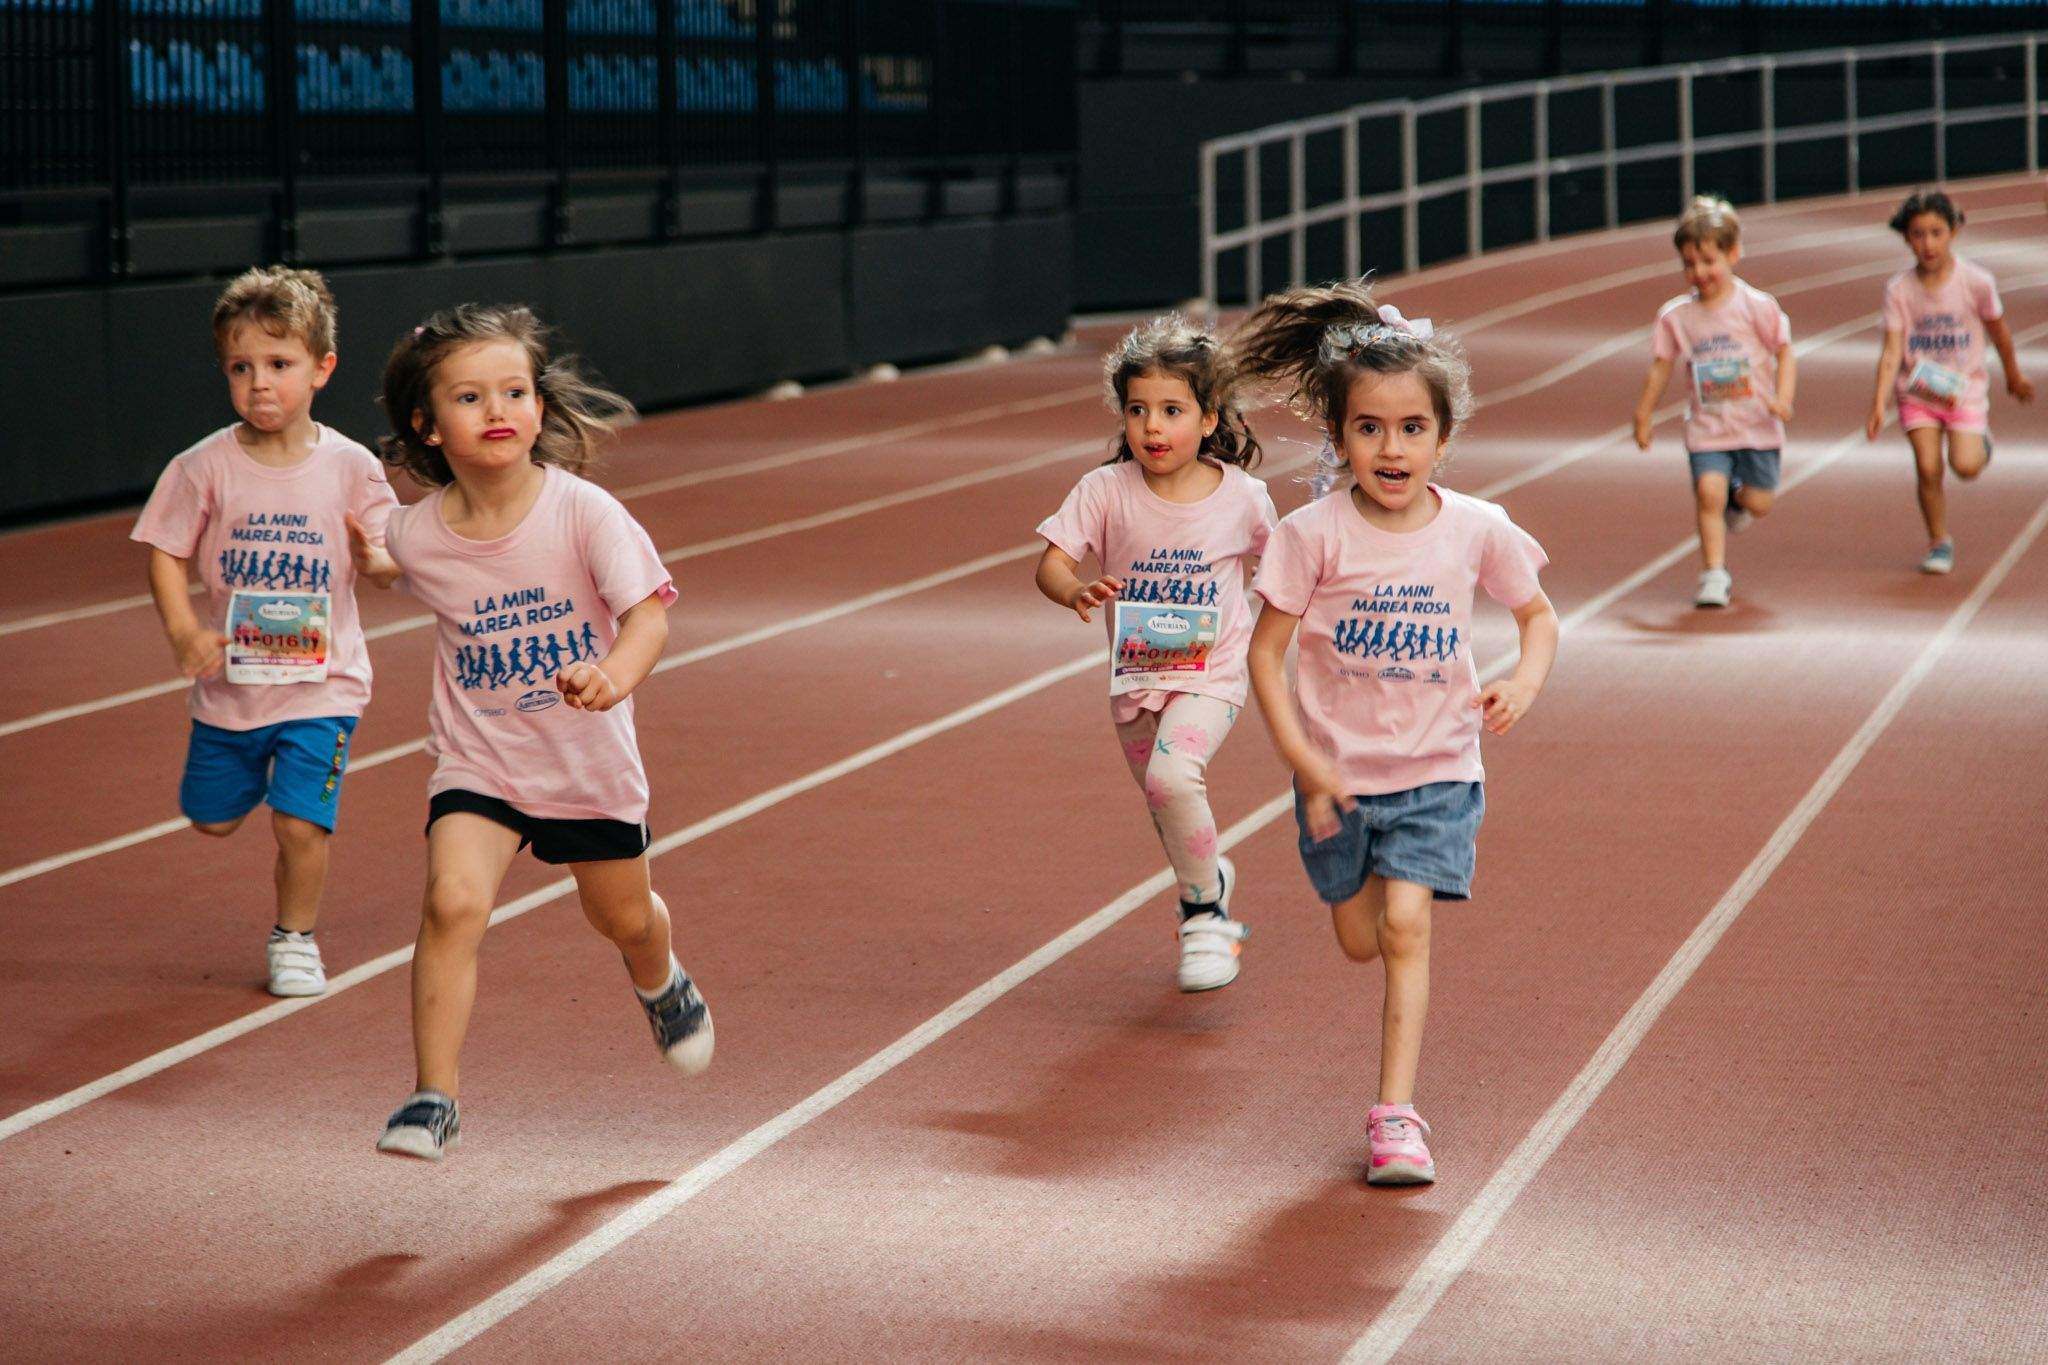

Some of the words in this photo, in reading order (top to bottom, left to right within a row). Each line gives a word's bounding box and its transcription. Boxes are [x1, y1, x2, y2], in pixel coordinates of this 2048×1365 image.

[248, 513, 266, 526] LA
[271, 513, 308, 527] MINI
[231, 528, 282, 543] MAREA
[286, 531, 323, 545] ROSA
[1150, 548, 1168, 560] LA
[1170, 549, 1203, 562] MINI
[1131, 561, 1180, 574] MAREA
[1374, 584, 1394, 597] LA
[1397, 585, 1434, 598] MINI
[475, 597, 496, 614] LA
[502, 587, 545, 609] MINI
[1351, 598, 1408, 614] MAREA
[1412, 601, 1451, 615] ROSA
[459, 613, 522, 635] MAREA
[527, 599, 573, 624] ROSA
